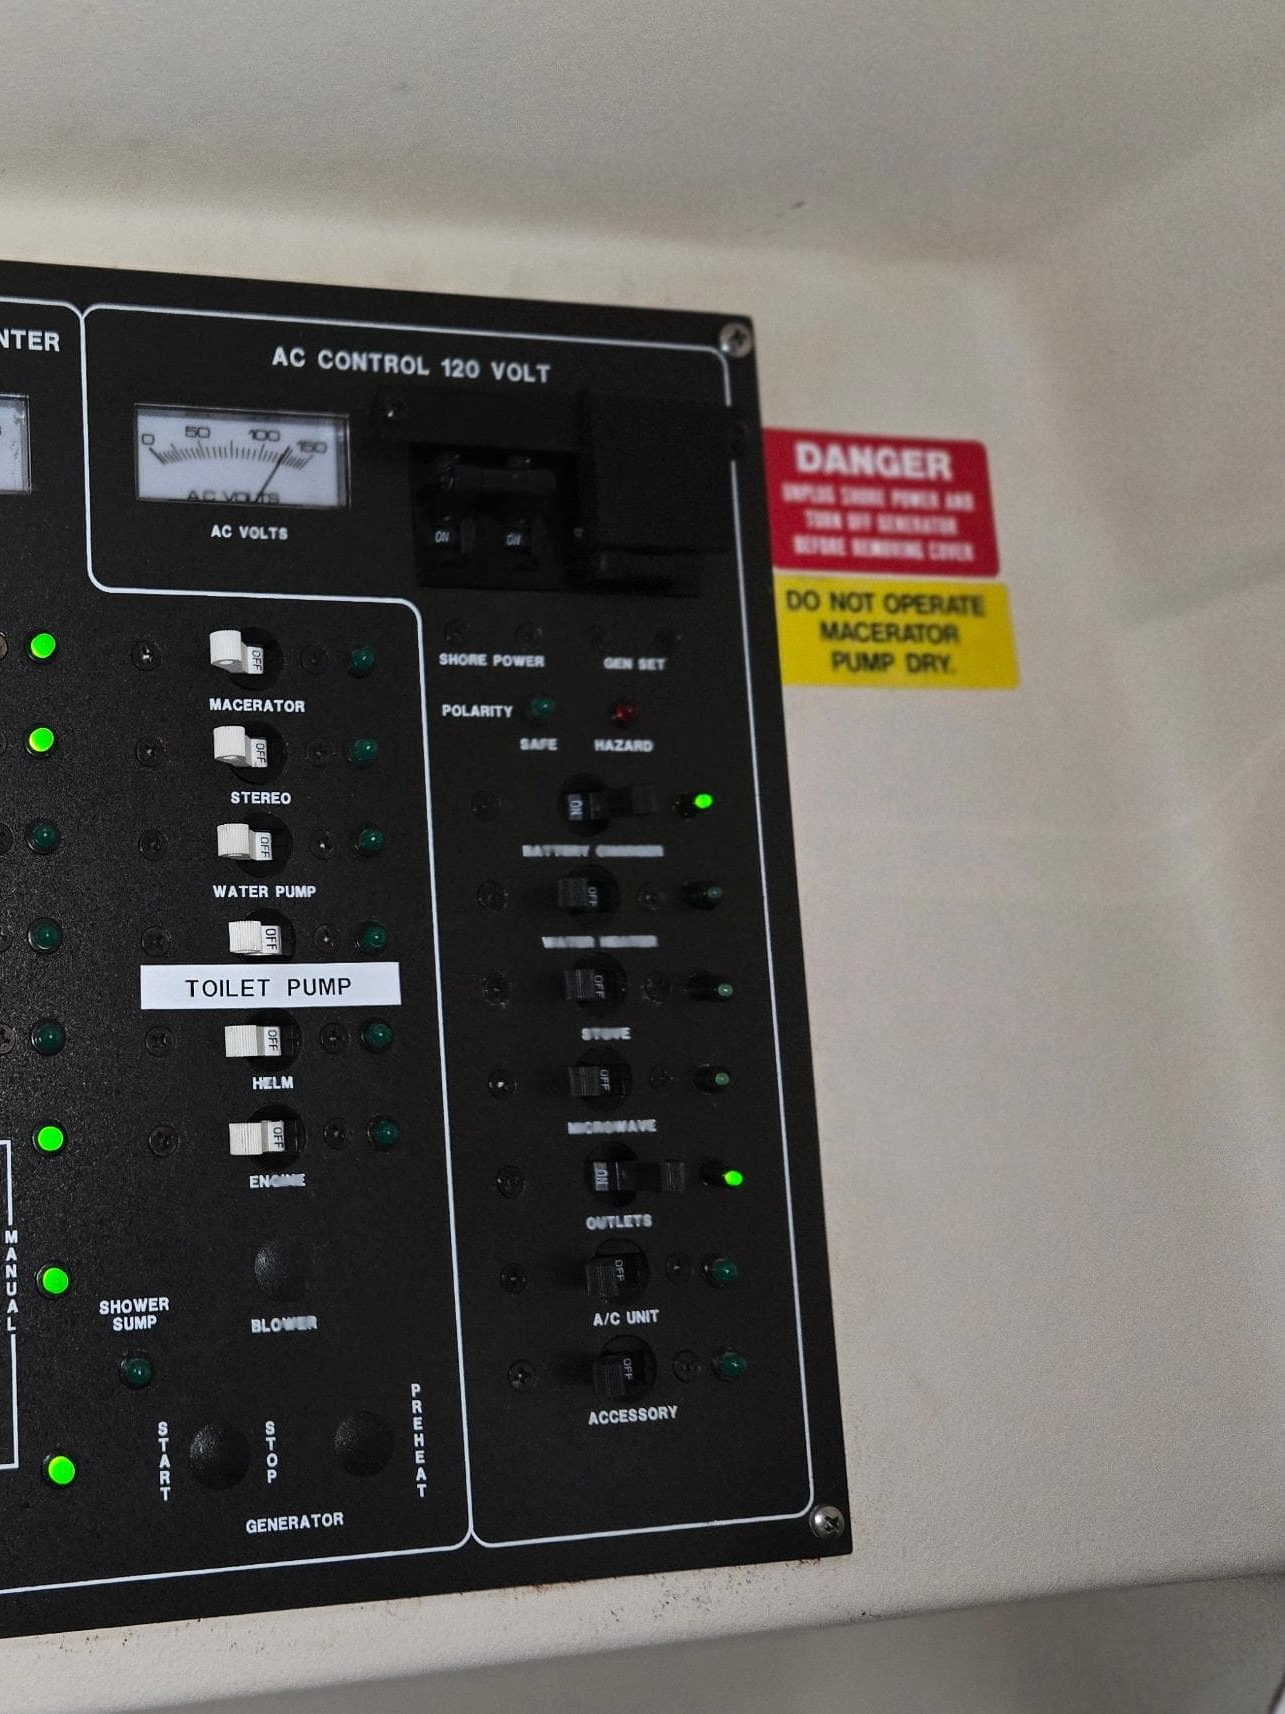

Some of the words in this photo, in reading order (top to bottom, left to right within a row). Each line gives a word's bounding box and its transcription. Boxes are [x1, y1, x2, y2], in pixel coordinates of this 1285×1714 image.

[272, 347, 305, 367] AC
[318, 350, 429, 375] CONTROL
[441, 358, 480, 378] 120
[491, 362, 550, 383] VOLT
[141, 433, 155, 446] 0
[185, 427, 210, 439] 50
[249, 430, 280, 442] 100
[794, 441, 953, 481] DANGER
[211, 525, 232, 537] AC
[239, 526, 288, 540] VOLTS
[435, 530, 449, 543] ON
[786, 590, 821, 611] DO
[830, 591, 874, 614] NOT
[883, 593, 986, 617] OPERATE
[820, 622, 959, 645] MACERATOR
[252, 650, 262, 671] OFF
[439, 653, 487, 666] SHORE
[493, 654, 544, 667] POWER
[604, 657, 633, 669] GEN
[638, 658, 665, 670] SET
[832, 652, 895, 672] PUMP
[210, 698, 305, 712] MACERATOR
[442, 704, 512, 717] POLARITY
[256, 743, 265, 764] OFF
[520, 738, 557, 751] SAFE
[594, 739, 653, 752] HAZARD
[231, 792, 291, 804] STEREO
[260, 836, 270, 860] OFF
[213, 885, 268, 897] WATER
[276, 885, 316, 897] PUMP
[266, 928, 276, 950] OFF
[185, 979, 270, 997] TOILET
[287, 977, 352, 996] PUMP
[268, 1029, 278, 1051] OFF
[253, 1076, 293, 1089] HELM
[568, 1119, 656, 1134] CROWAVE
[273, 1126, 284, 1149] OFF
[586, 1214, 652, 1230] OUTLETS
[614, 1259, 624, 1281] OFF
[5, 1230, 19, 1331] MANUAL
[99, 1297, 170, 1315] SHOWER
[112, 1315, 157, 1332] SUMP
[593, 1312, 620, 1326] A/C
[627, 1310, 659, 1324] UNIT
[623, 1358, 633, 1380] OFF
[589, 1405, 677, 1425] ACCESSORY
[410, 1383, 427, 1499] PREHEAT
[157, 1420, 171, 1502] START
[264, 1420, 279, 1484] STOP
[246, 1512, 343, 1533] GENERATOR
